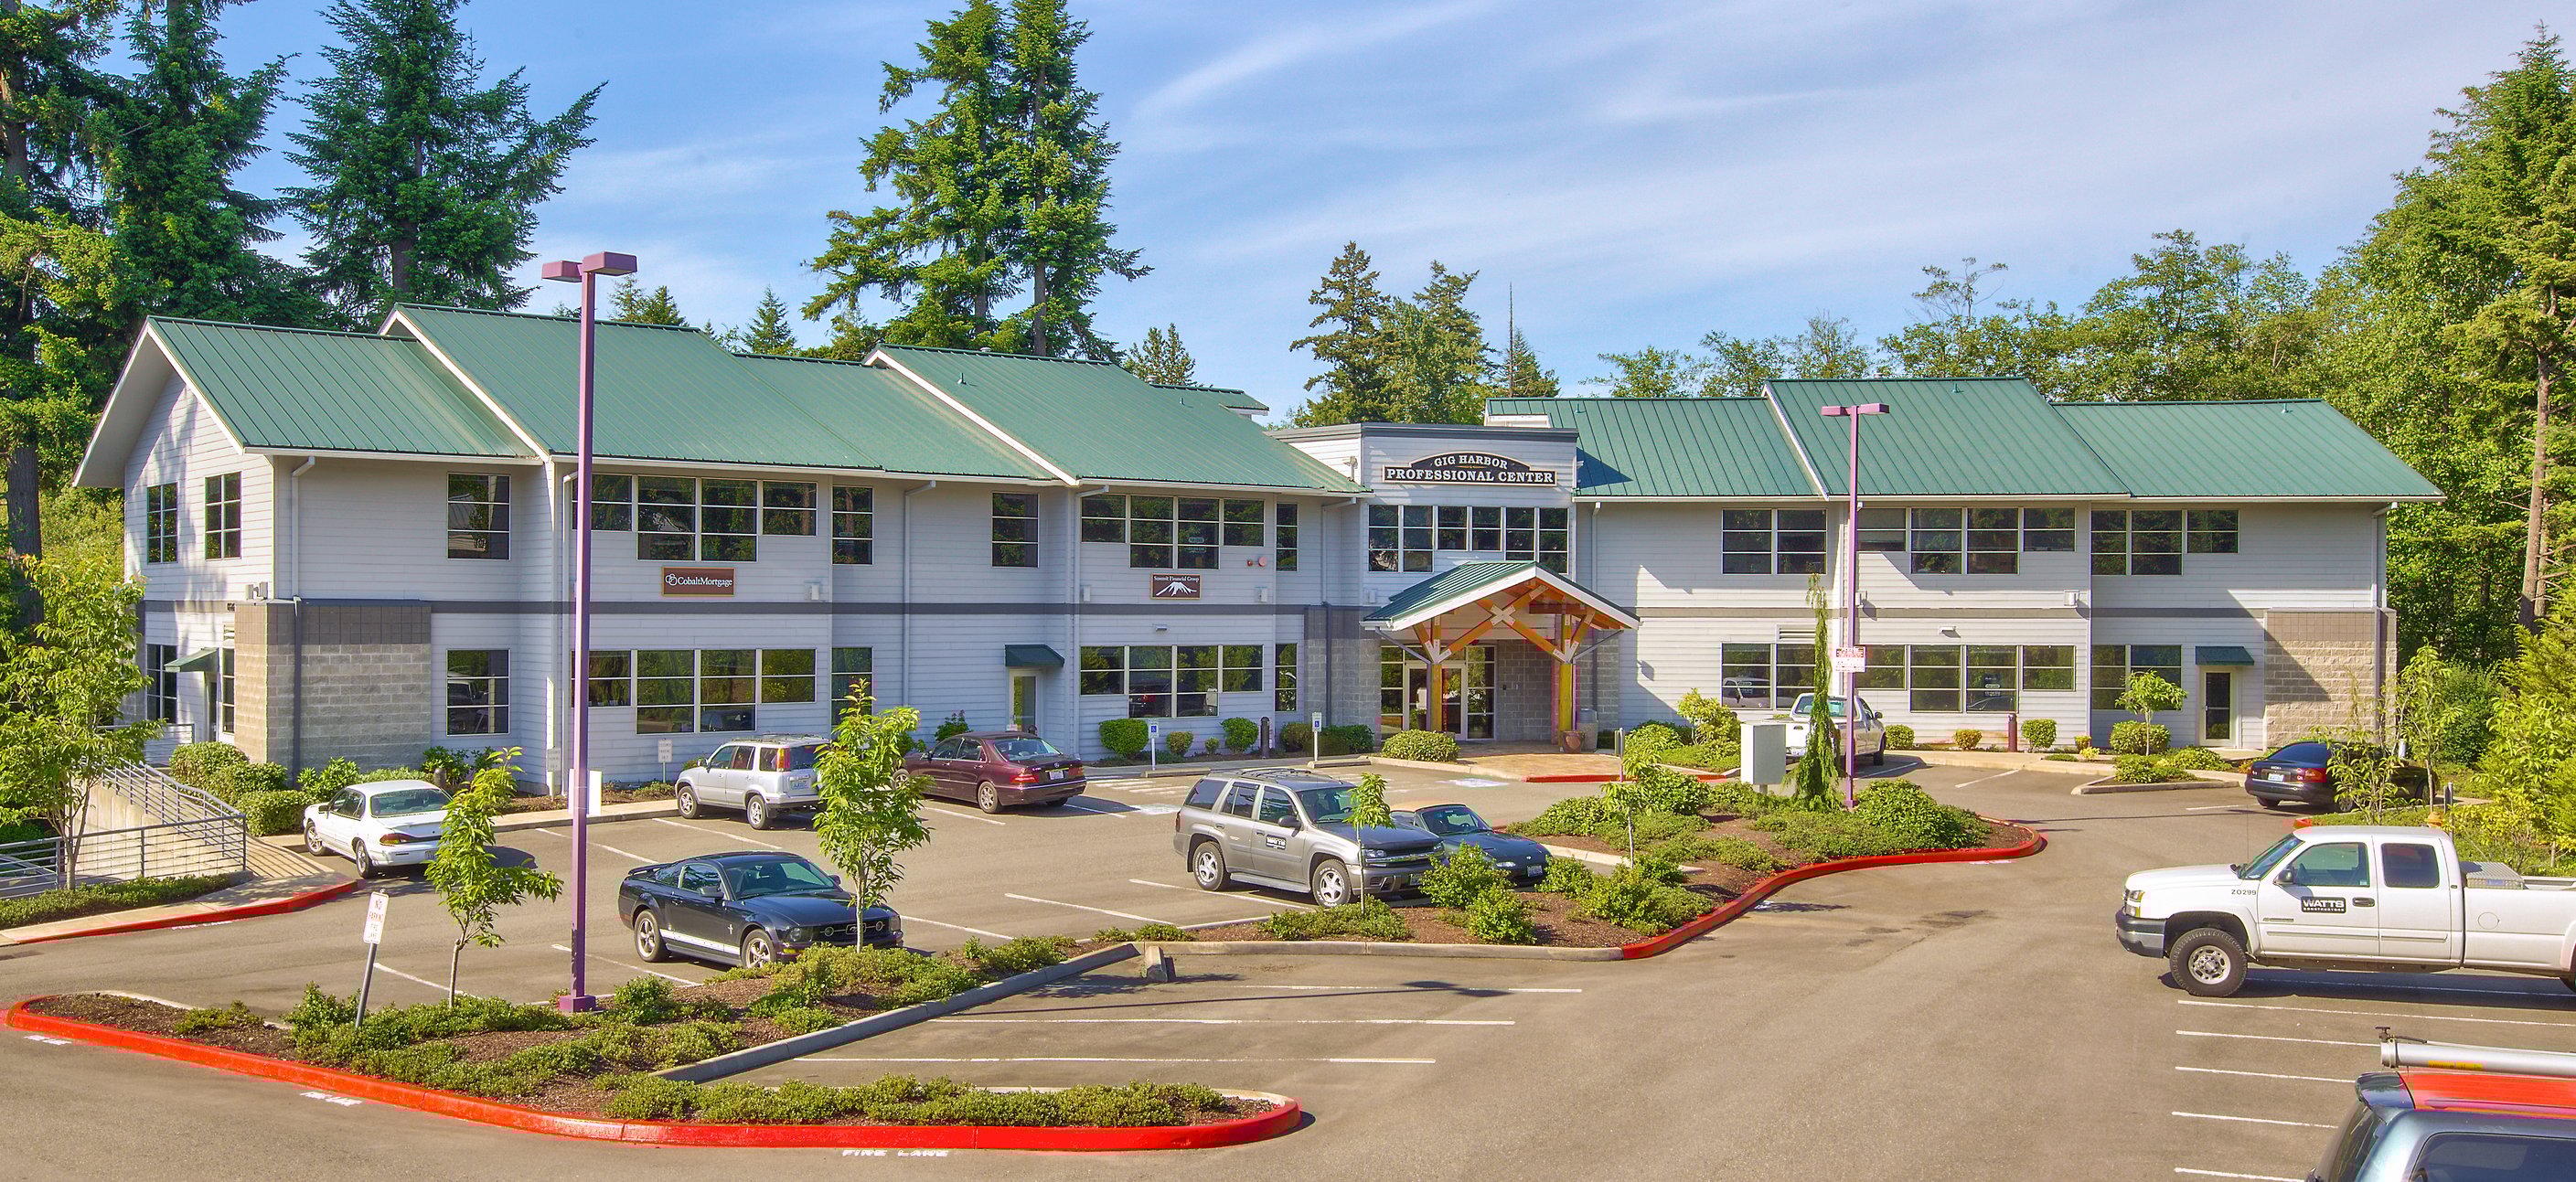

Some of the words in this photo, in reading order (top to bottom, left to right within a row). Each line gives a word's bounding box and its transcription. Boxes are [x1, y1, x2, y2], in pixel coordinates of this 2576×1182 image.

[1434, 455, 1456, 467] GIG
[1459, 454, 1508, 469] HARBOR
[1386, 468, 1495, 481] PROFESSIONAL
[1498, 472, 1554, 483] CENTER
[2303, 900, 2345, 908] WATTS
